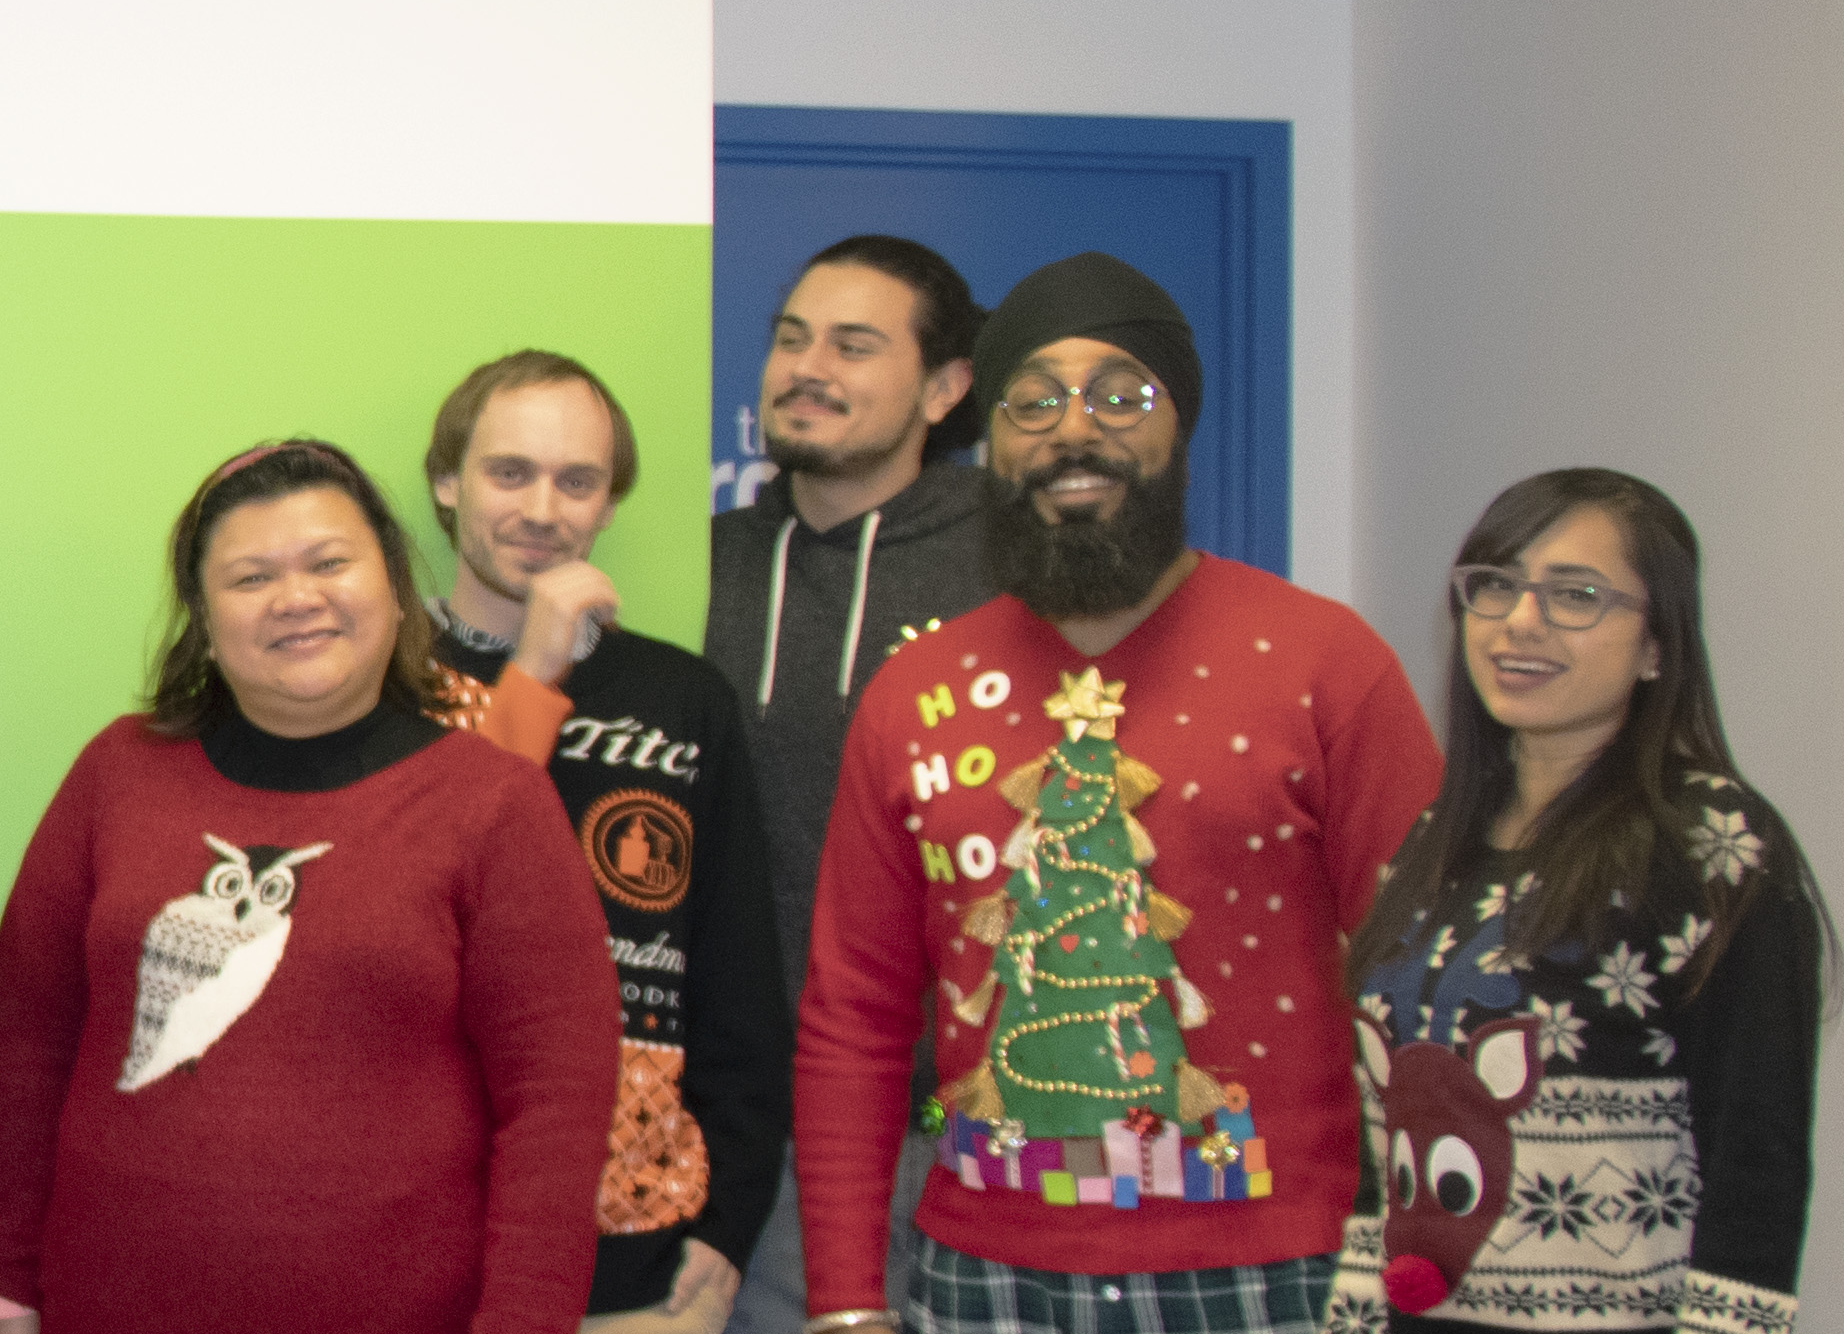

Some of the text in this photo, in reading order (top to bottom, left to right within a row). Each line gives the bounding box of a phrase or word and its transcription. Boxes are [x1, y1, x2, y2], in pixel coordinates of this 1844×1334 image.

[916, 669, 1011, 729] HO
[912, 744, 997, 801] HO
[919, 833, 997, 884] HO
[621, 982, 680, 1008] ODK
